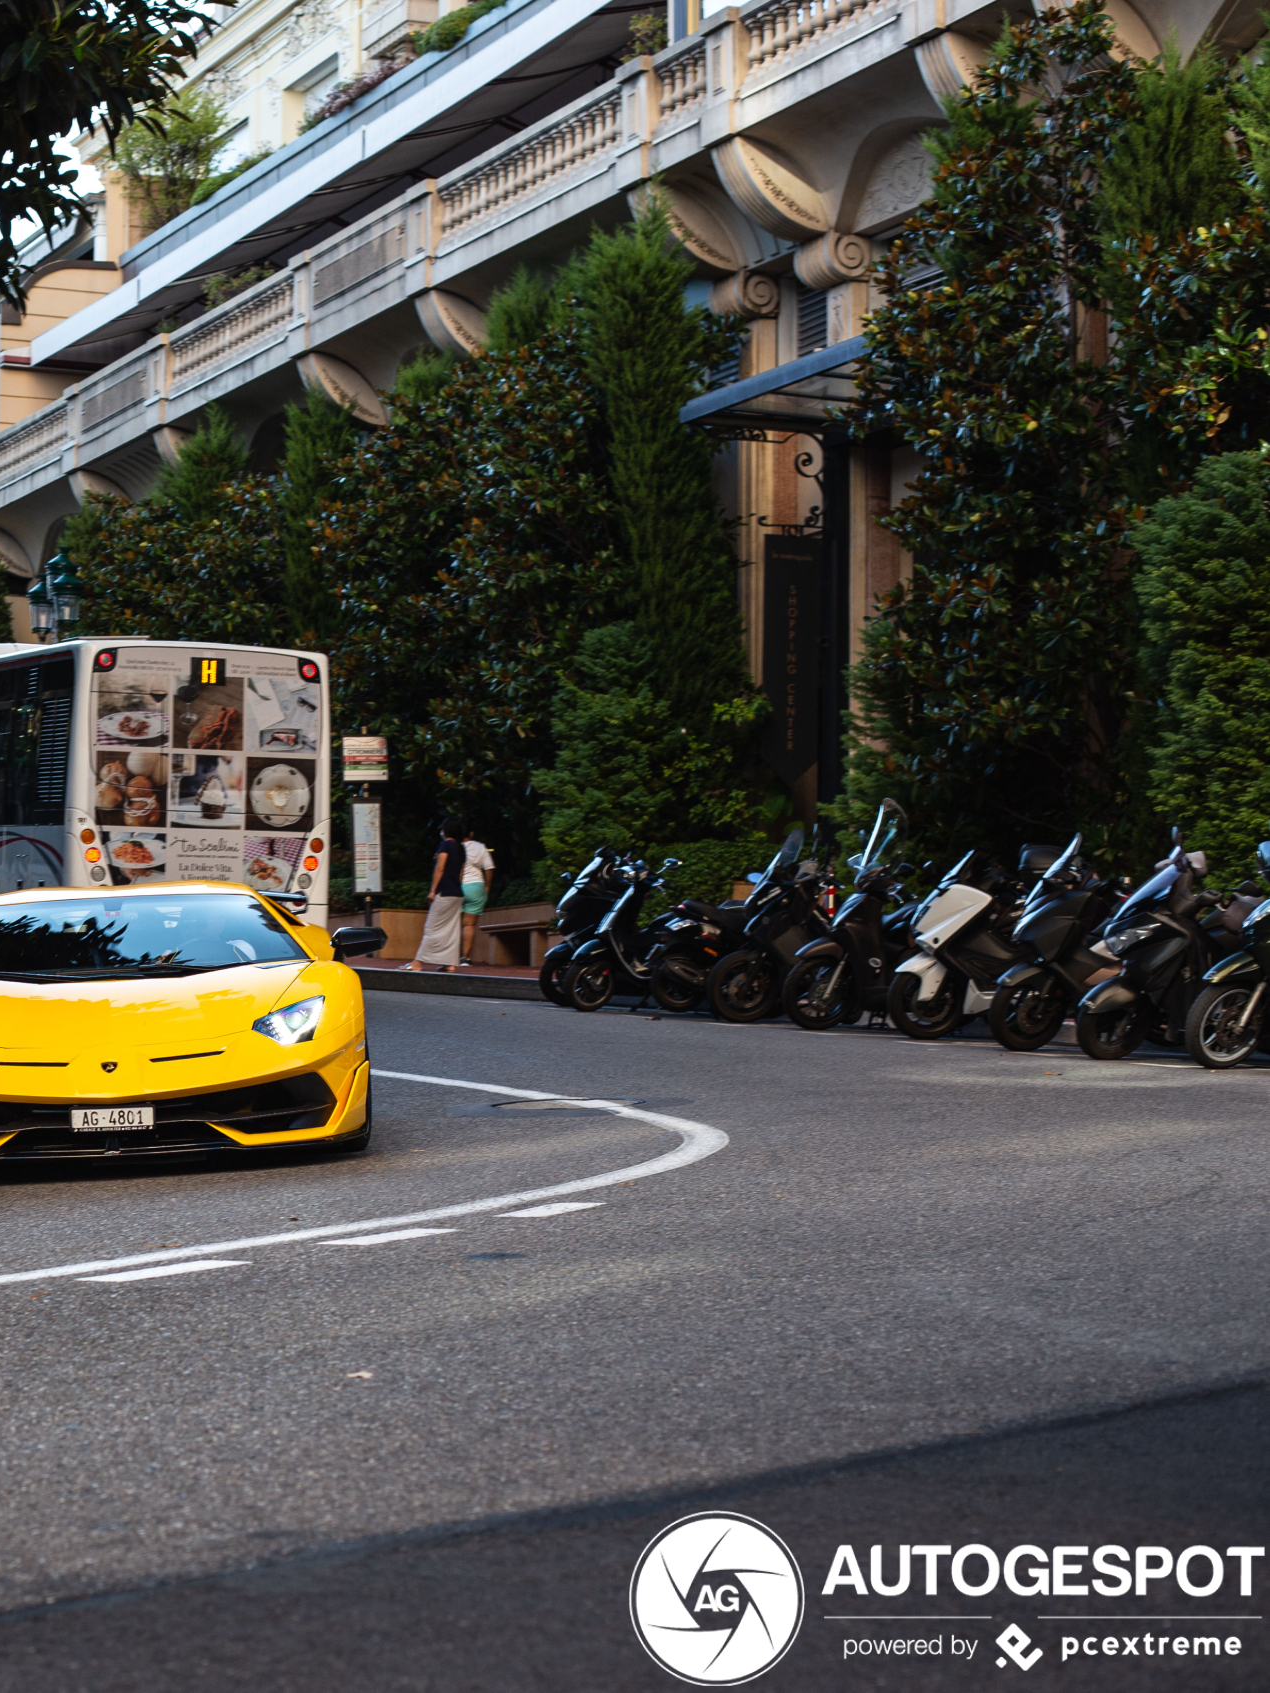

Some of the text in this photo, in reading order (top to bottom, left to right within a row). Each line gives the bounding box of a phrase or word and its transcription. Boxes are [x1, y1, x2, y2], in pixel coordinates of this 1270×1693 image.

[201, 659, 218, 684] H
[786, 585, 798, 750] SHOPPING CENTER
